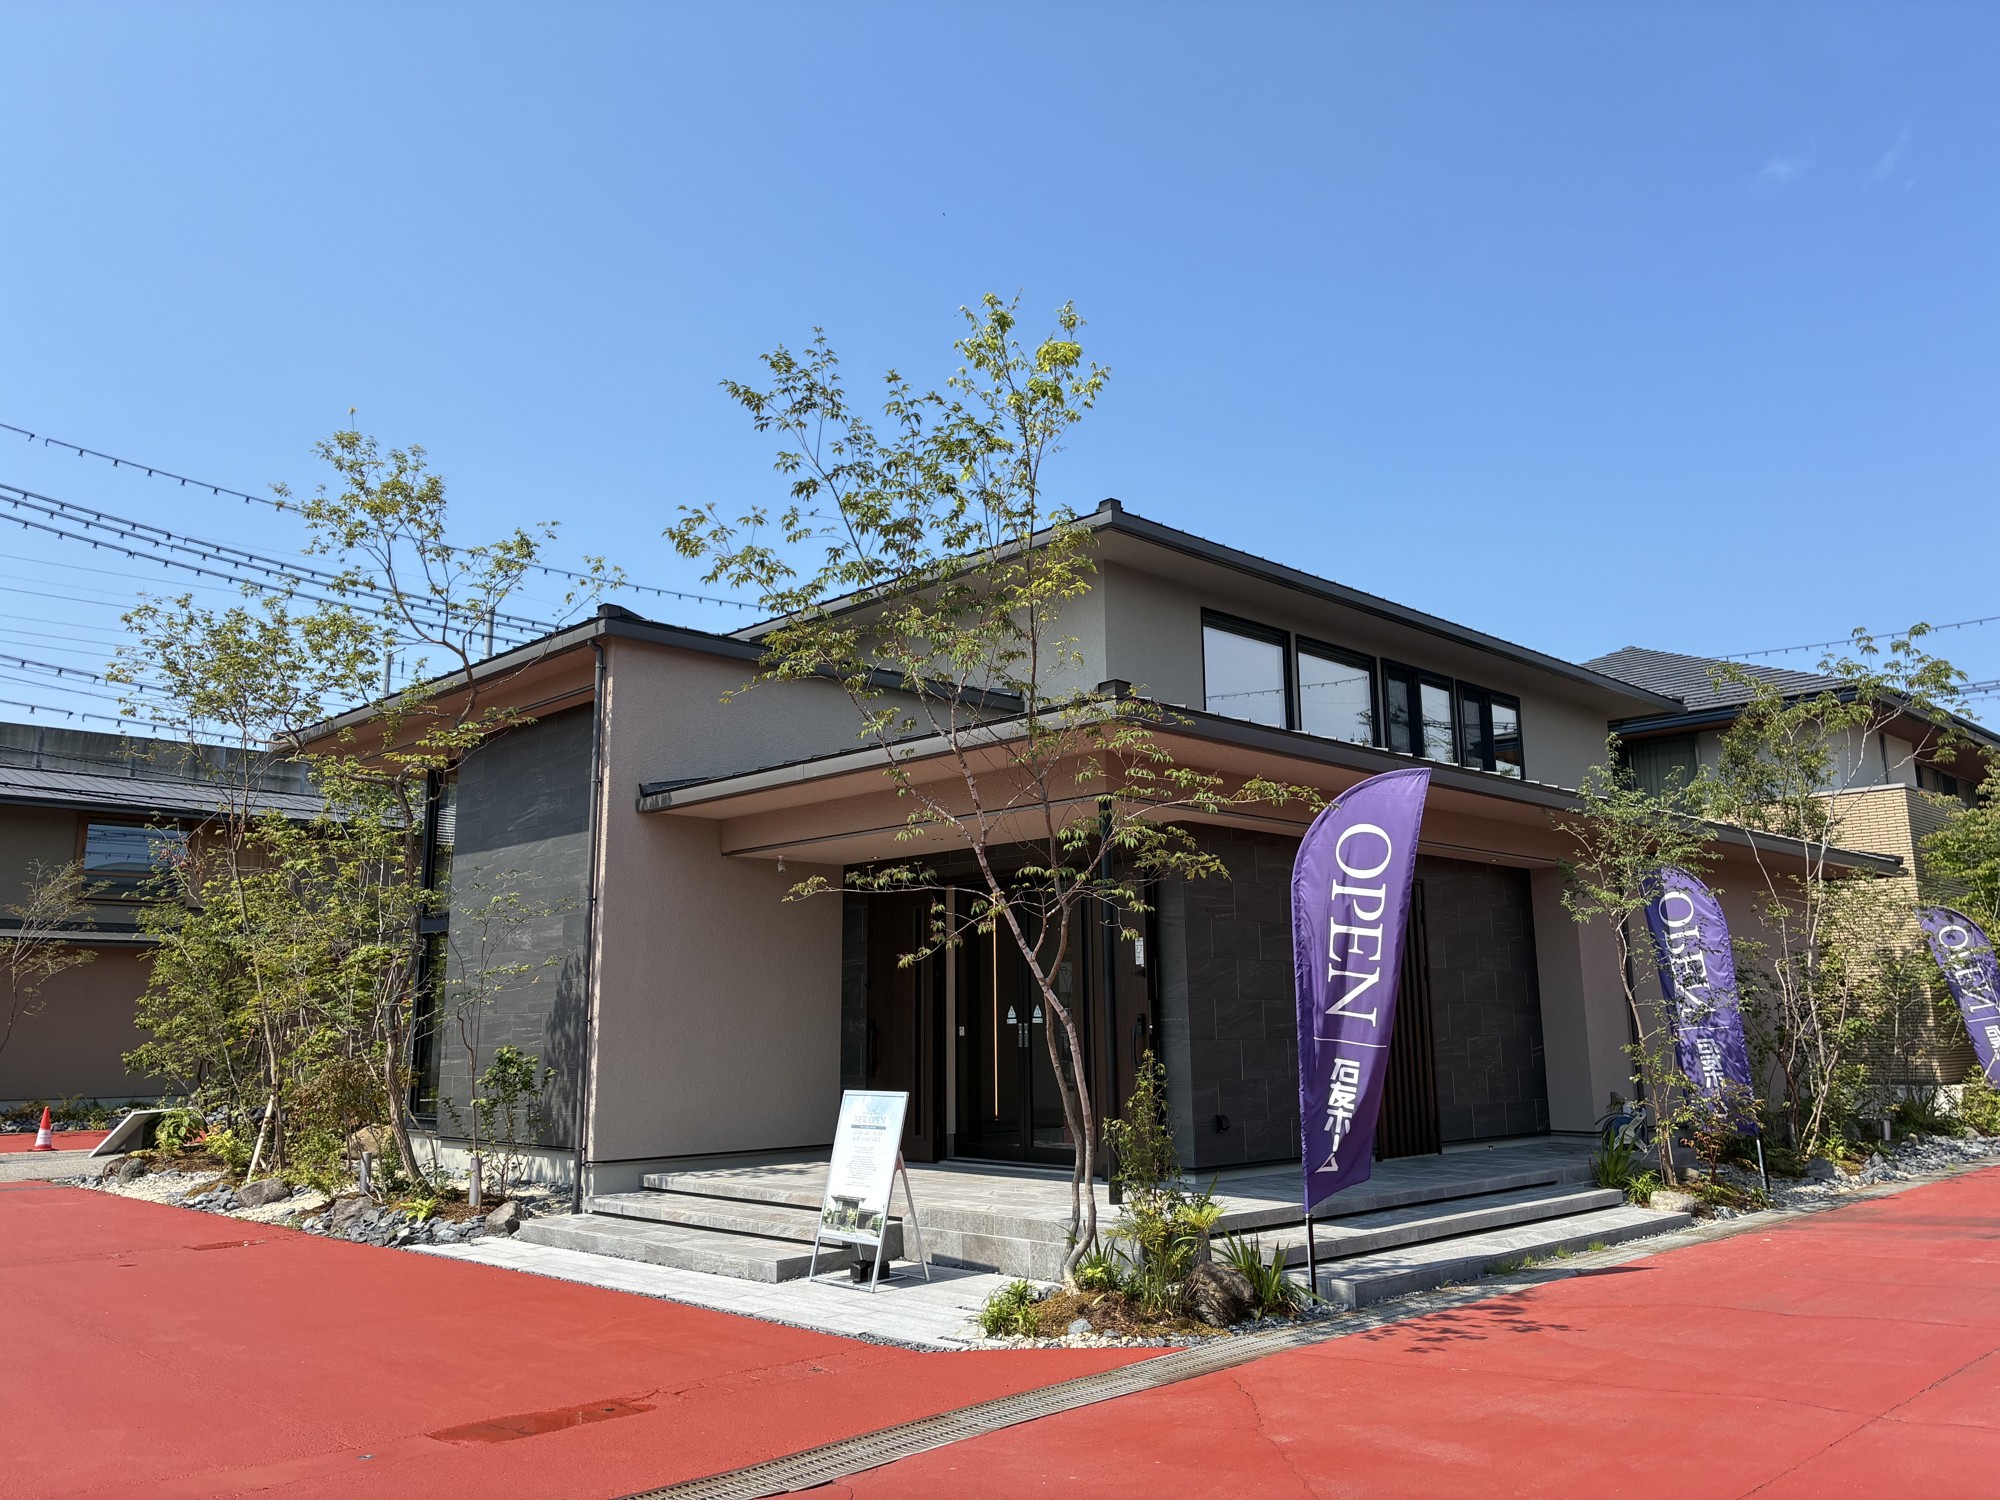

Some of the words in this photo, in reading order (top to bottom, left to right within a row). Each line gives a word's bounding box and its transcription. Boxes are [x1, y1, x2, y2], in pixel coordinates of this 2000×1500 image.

[1324, 823, 1392, 1028] OPEN
[869, 1116, 886, 1125] OPEN
[1315, 1057, 1361, 1173] 石友ホーム
